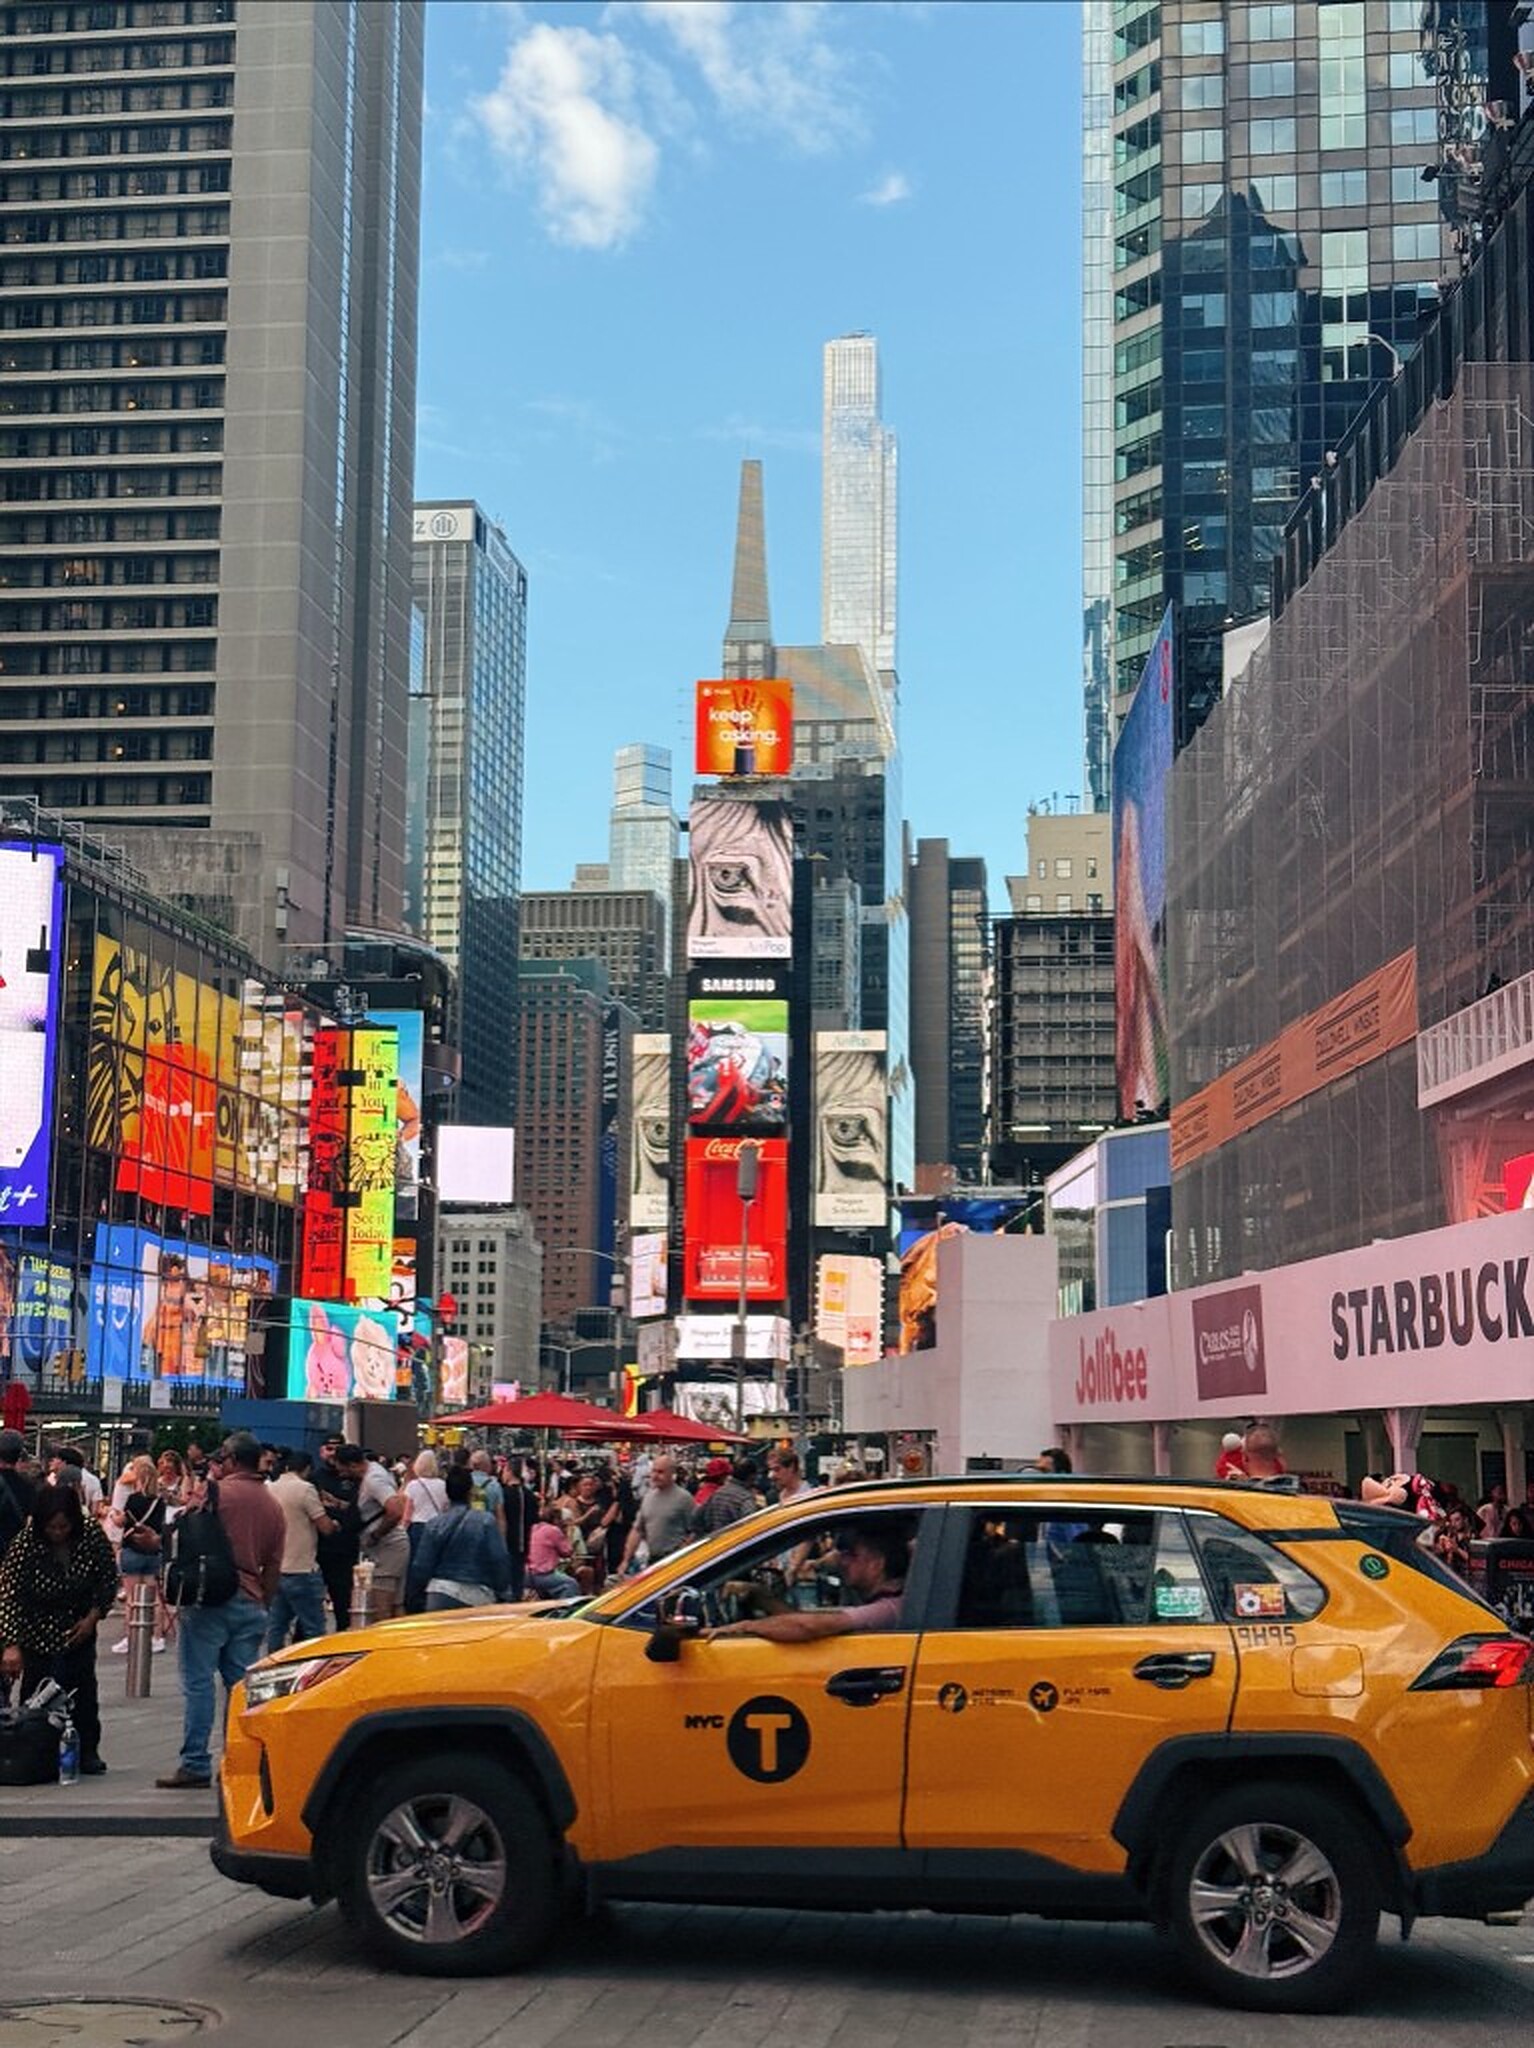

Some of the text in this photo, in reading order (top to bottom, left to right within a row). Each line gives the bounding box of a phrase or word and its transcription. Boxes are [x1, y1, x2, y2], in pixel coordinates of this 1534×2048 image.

[709, 706, 754, 725] keep
[702, 978, 777, 993] SAMSUNG
[1076, 1325, 1147, 1406] Jollibee
[1237, 1625, 1297, 1646] 9H95
[684, 1712, 792, 1773] NYC T
